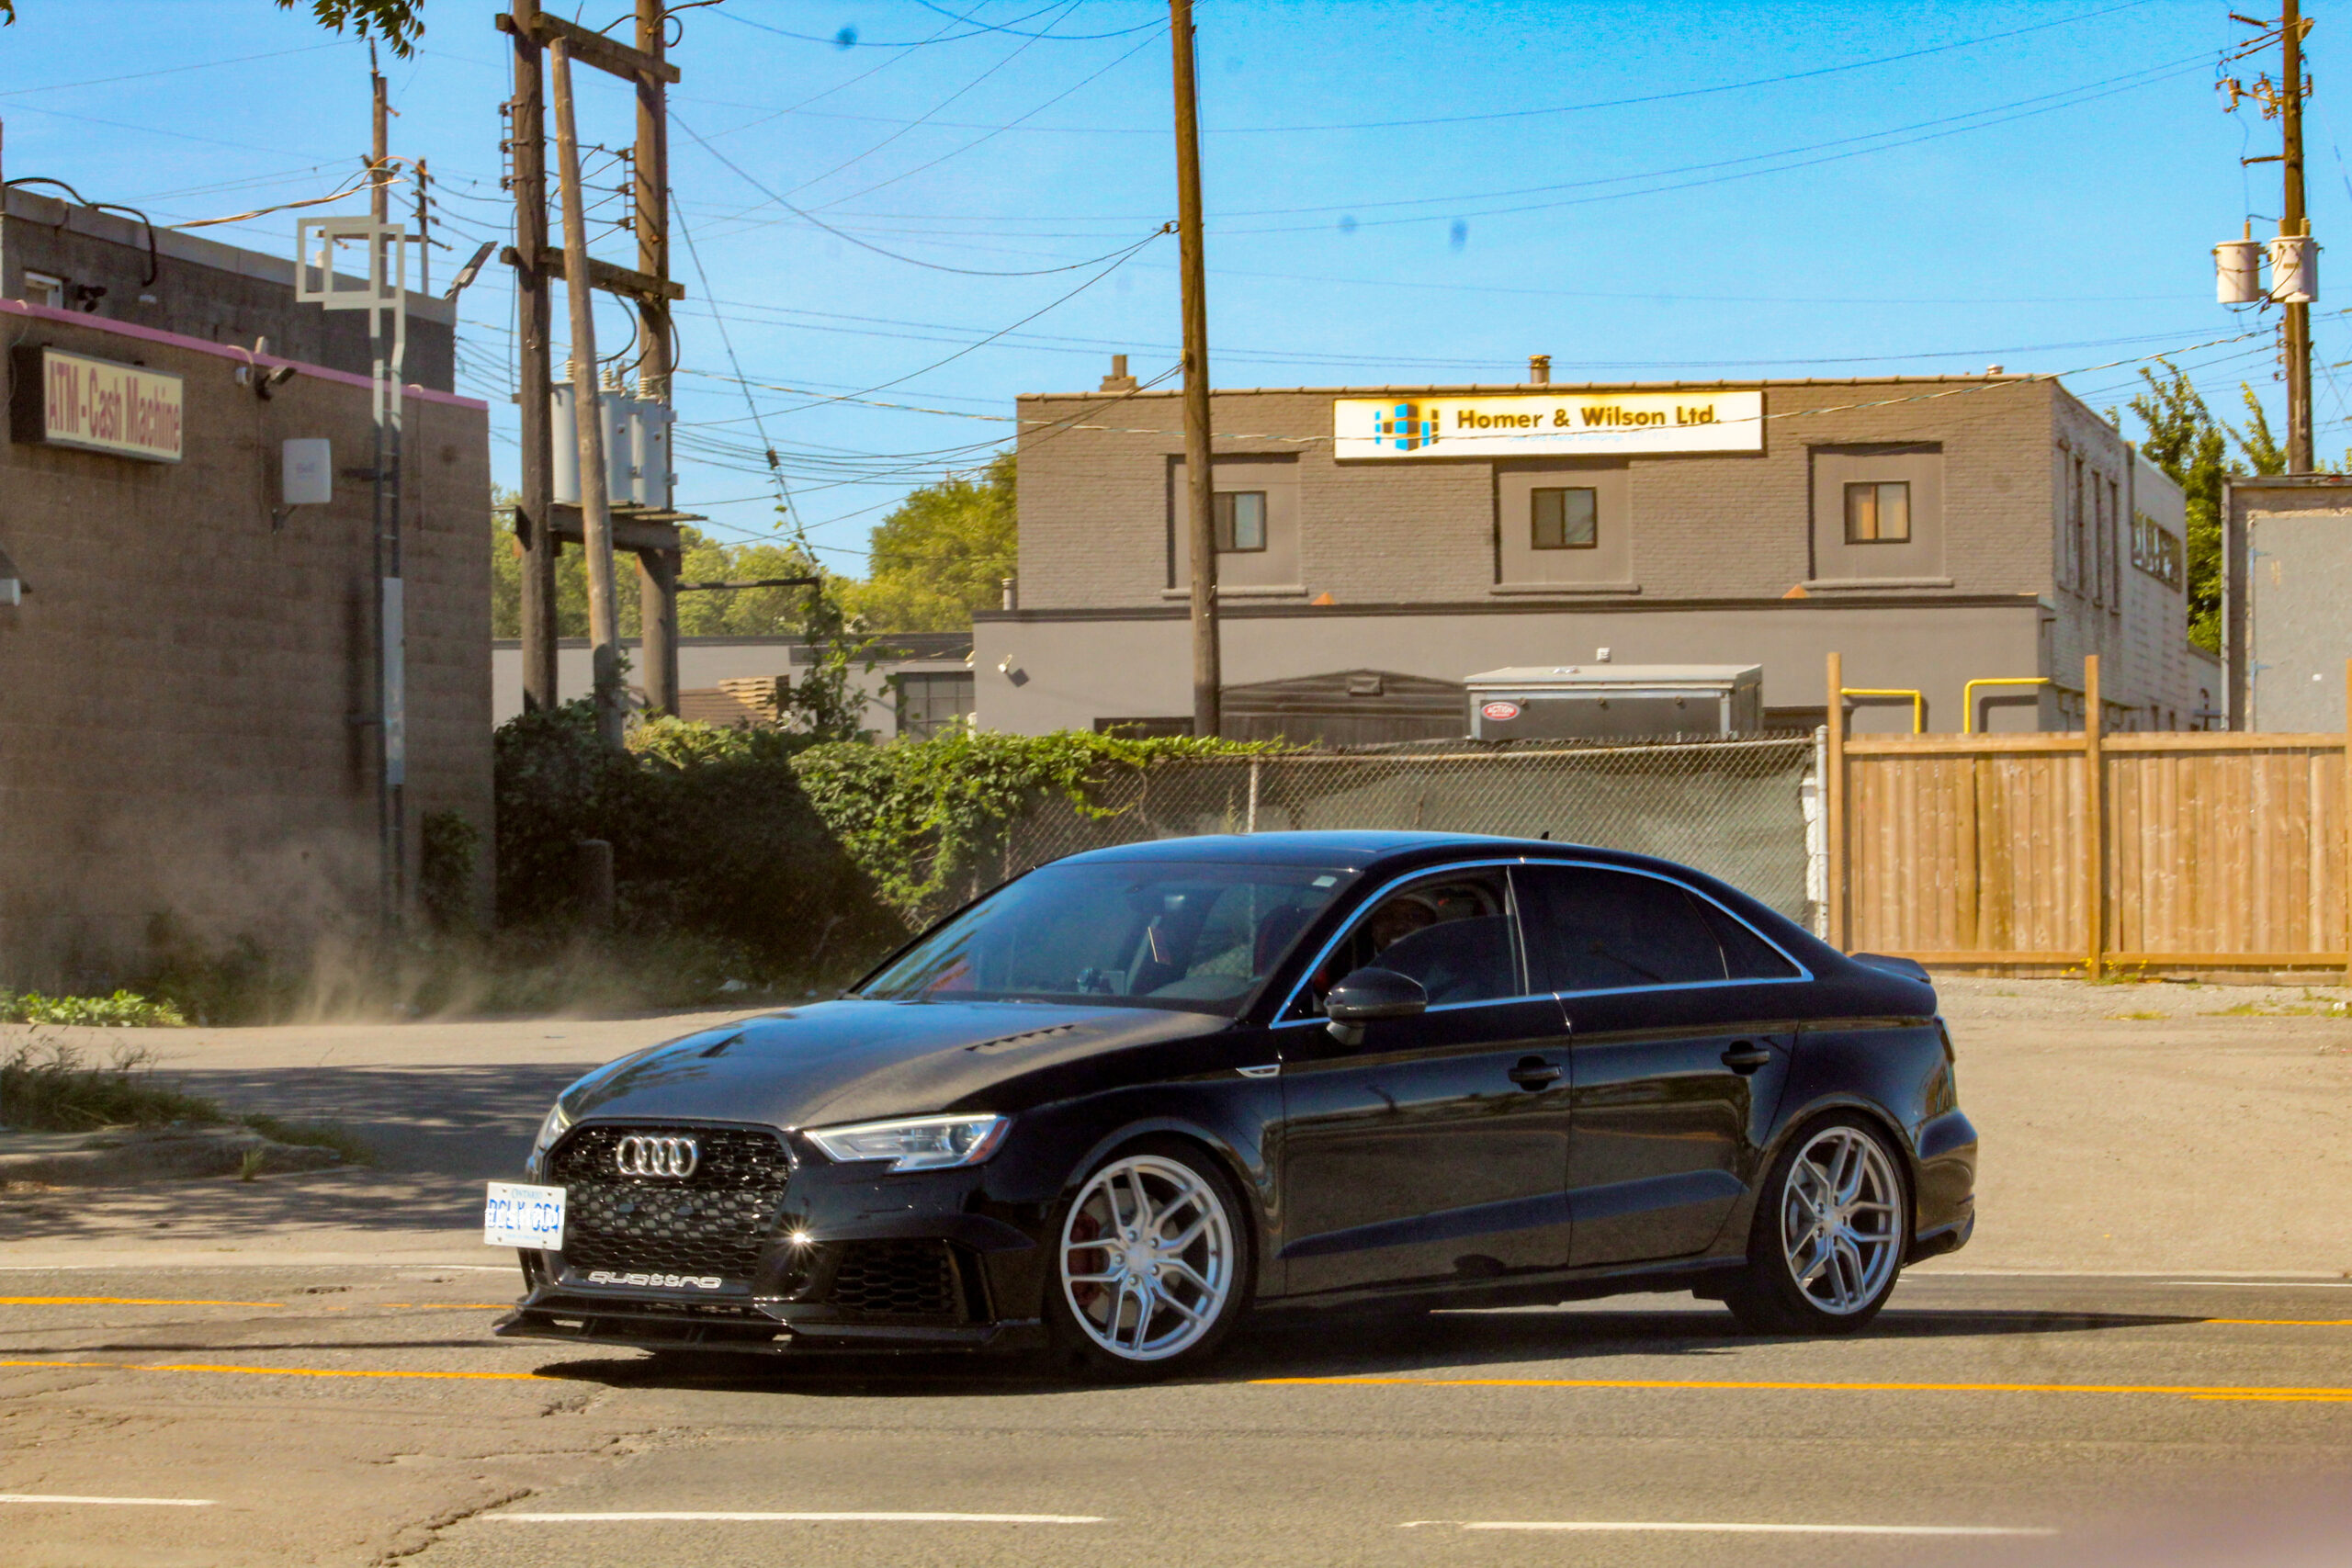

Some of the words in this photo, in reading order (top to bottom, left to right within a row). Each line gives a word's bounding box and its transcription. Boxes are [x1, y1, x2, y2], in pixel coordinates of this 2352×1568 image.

[49, 360, 79, 434] ATM
[89, 367, 121, 441] Cash
[126, 376, 178, 452] Machine
[1457, 409, 1543, 428] Homer
[1554, 408, 1571, 427] &
[1581, 406, 1666, 425] Wilson
[1677, 403, 1721, 423] Ltd.
[588, 1270, 722, 1289] quattro
